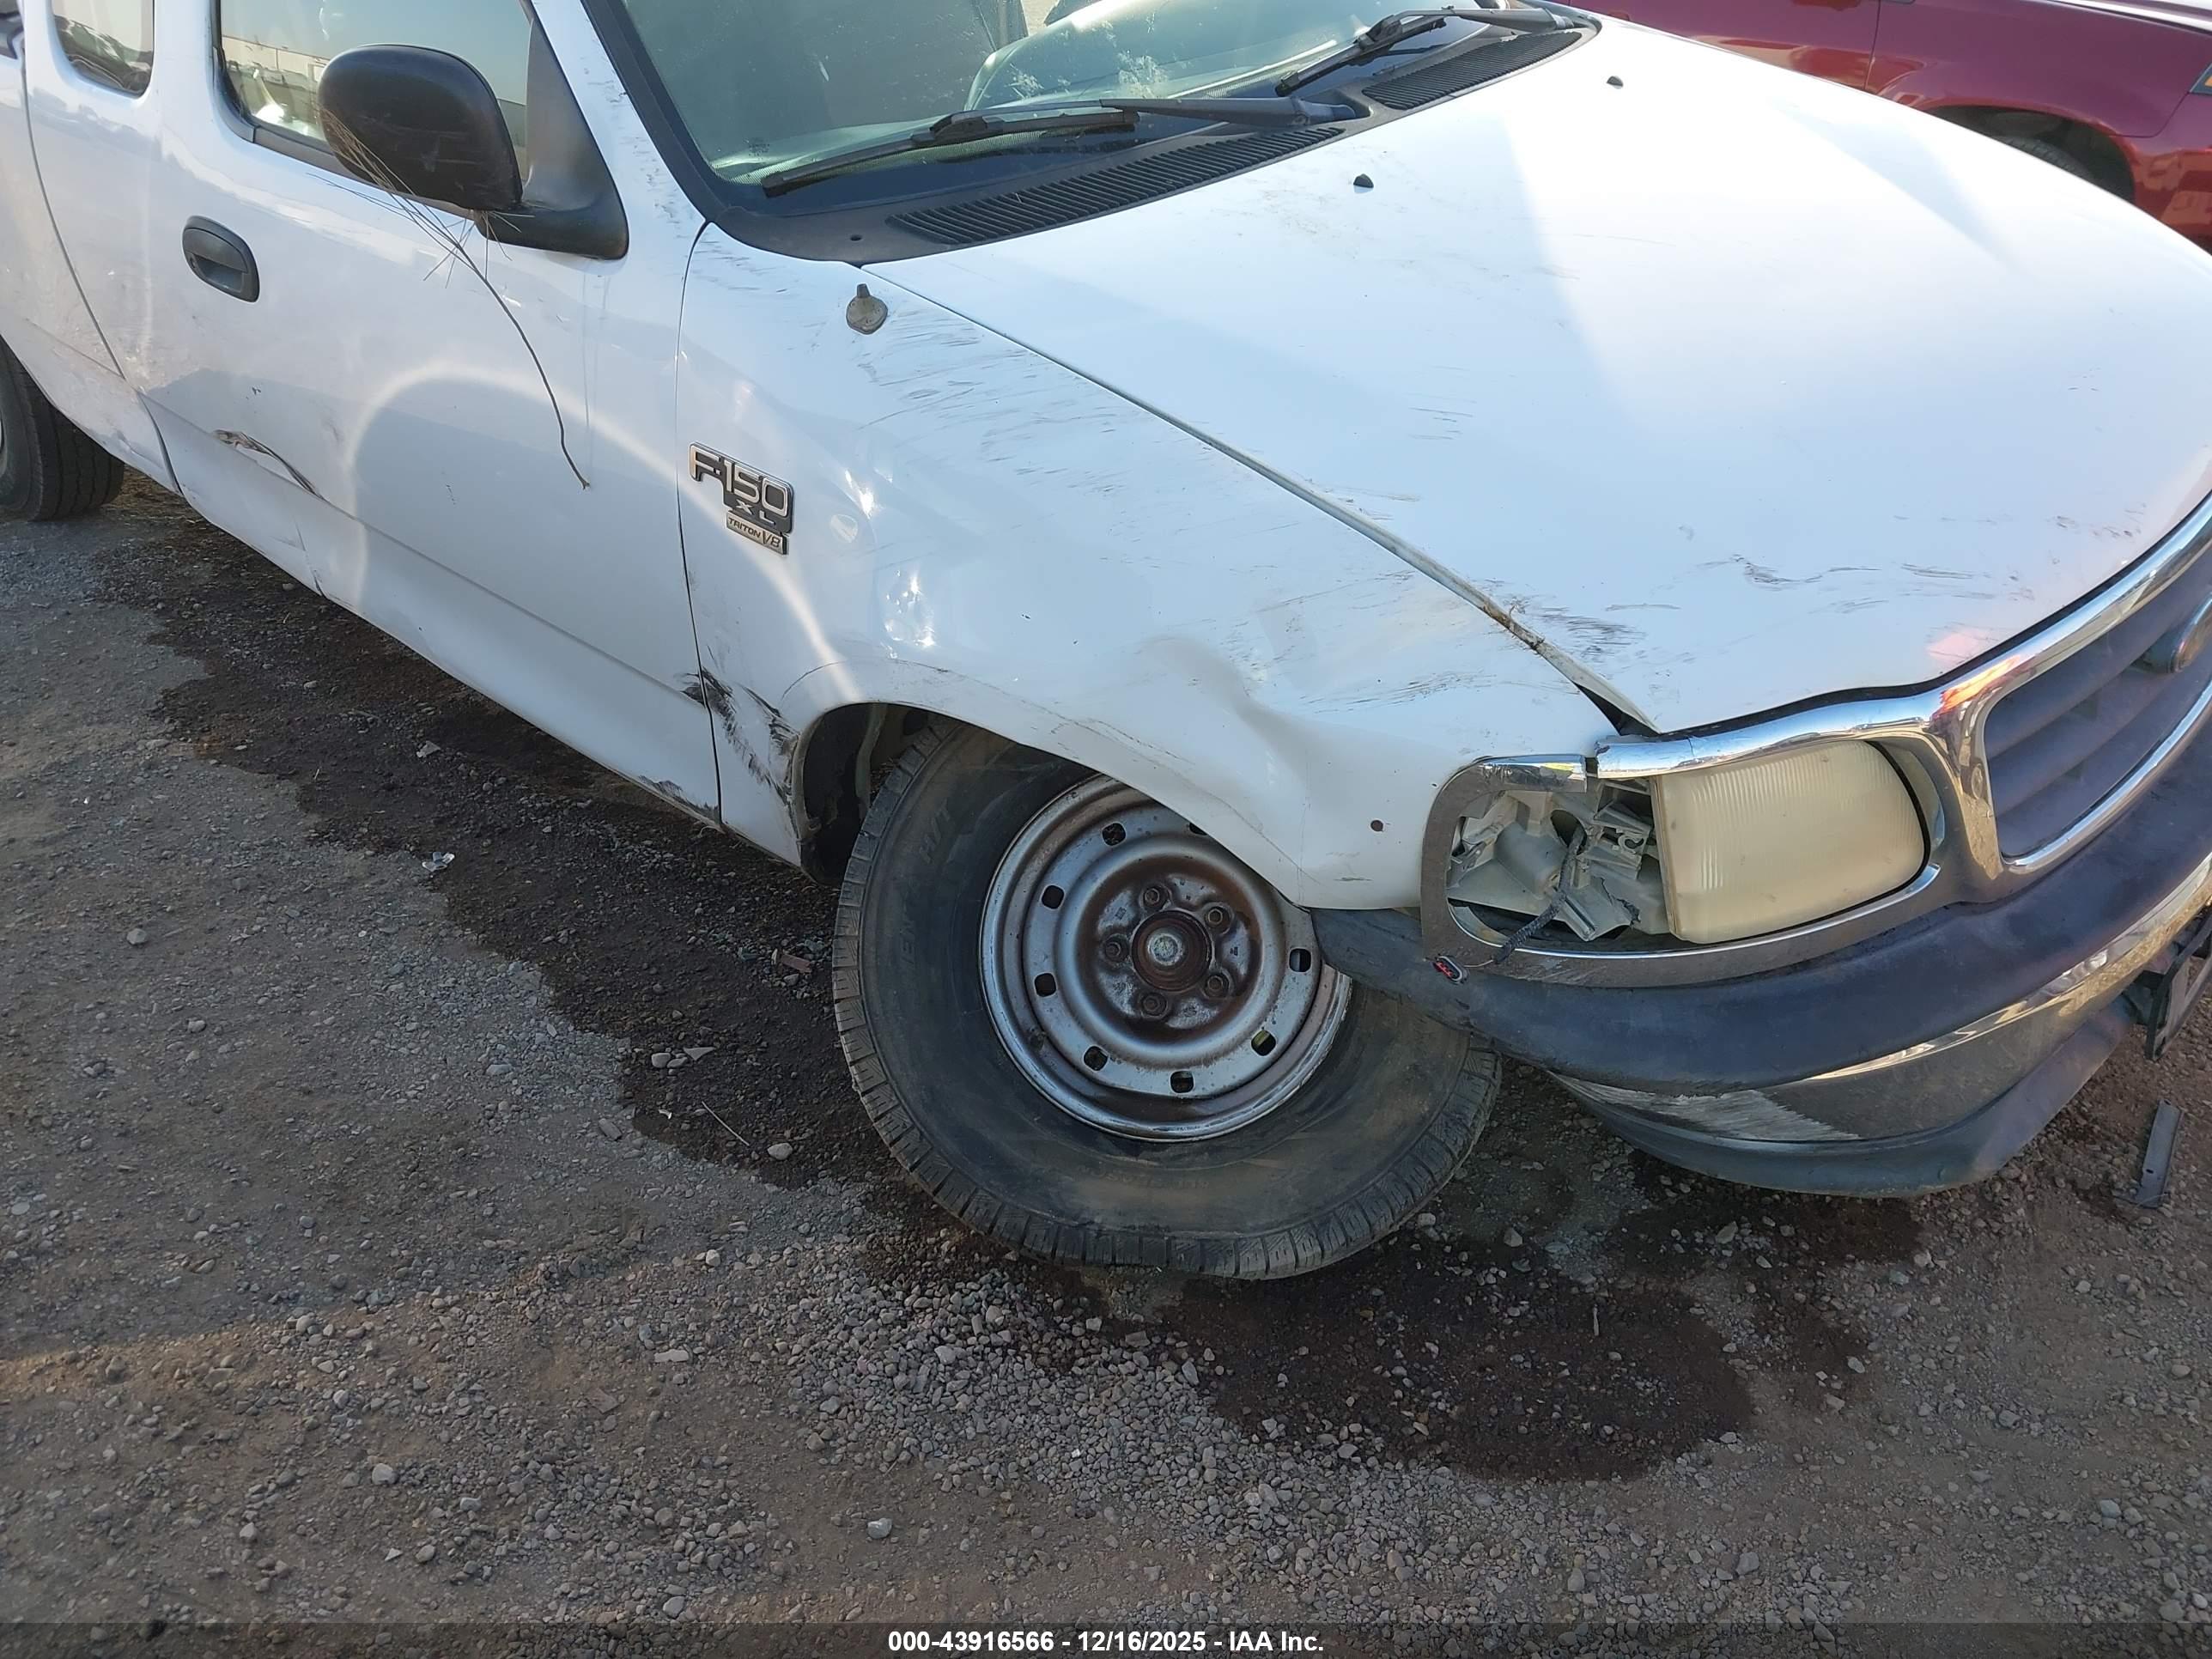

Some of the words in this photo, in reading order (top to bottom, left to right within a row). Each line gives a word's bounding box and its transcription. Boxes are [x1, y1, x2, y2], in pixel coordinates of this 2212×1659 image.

[736, 499, 776, 526] XL
[728, 518, 762, 538] TRITON
[762, 530, 781, 548] V8
